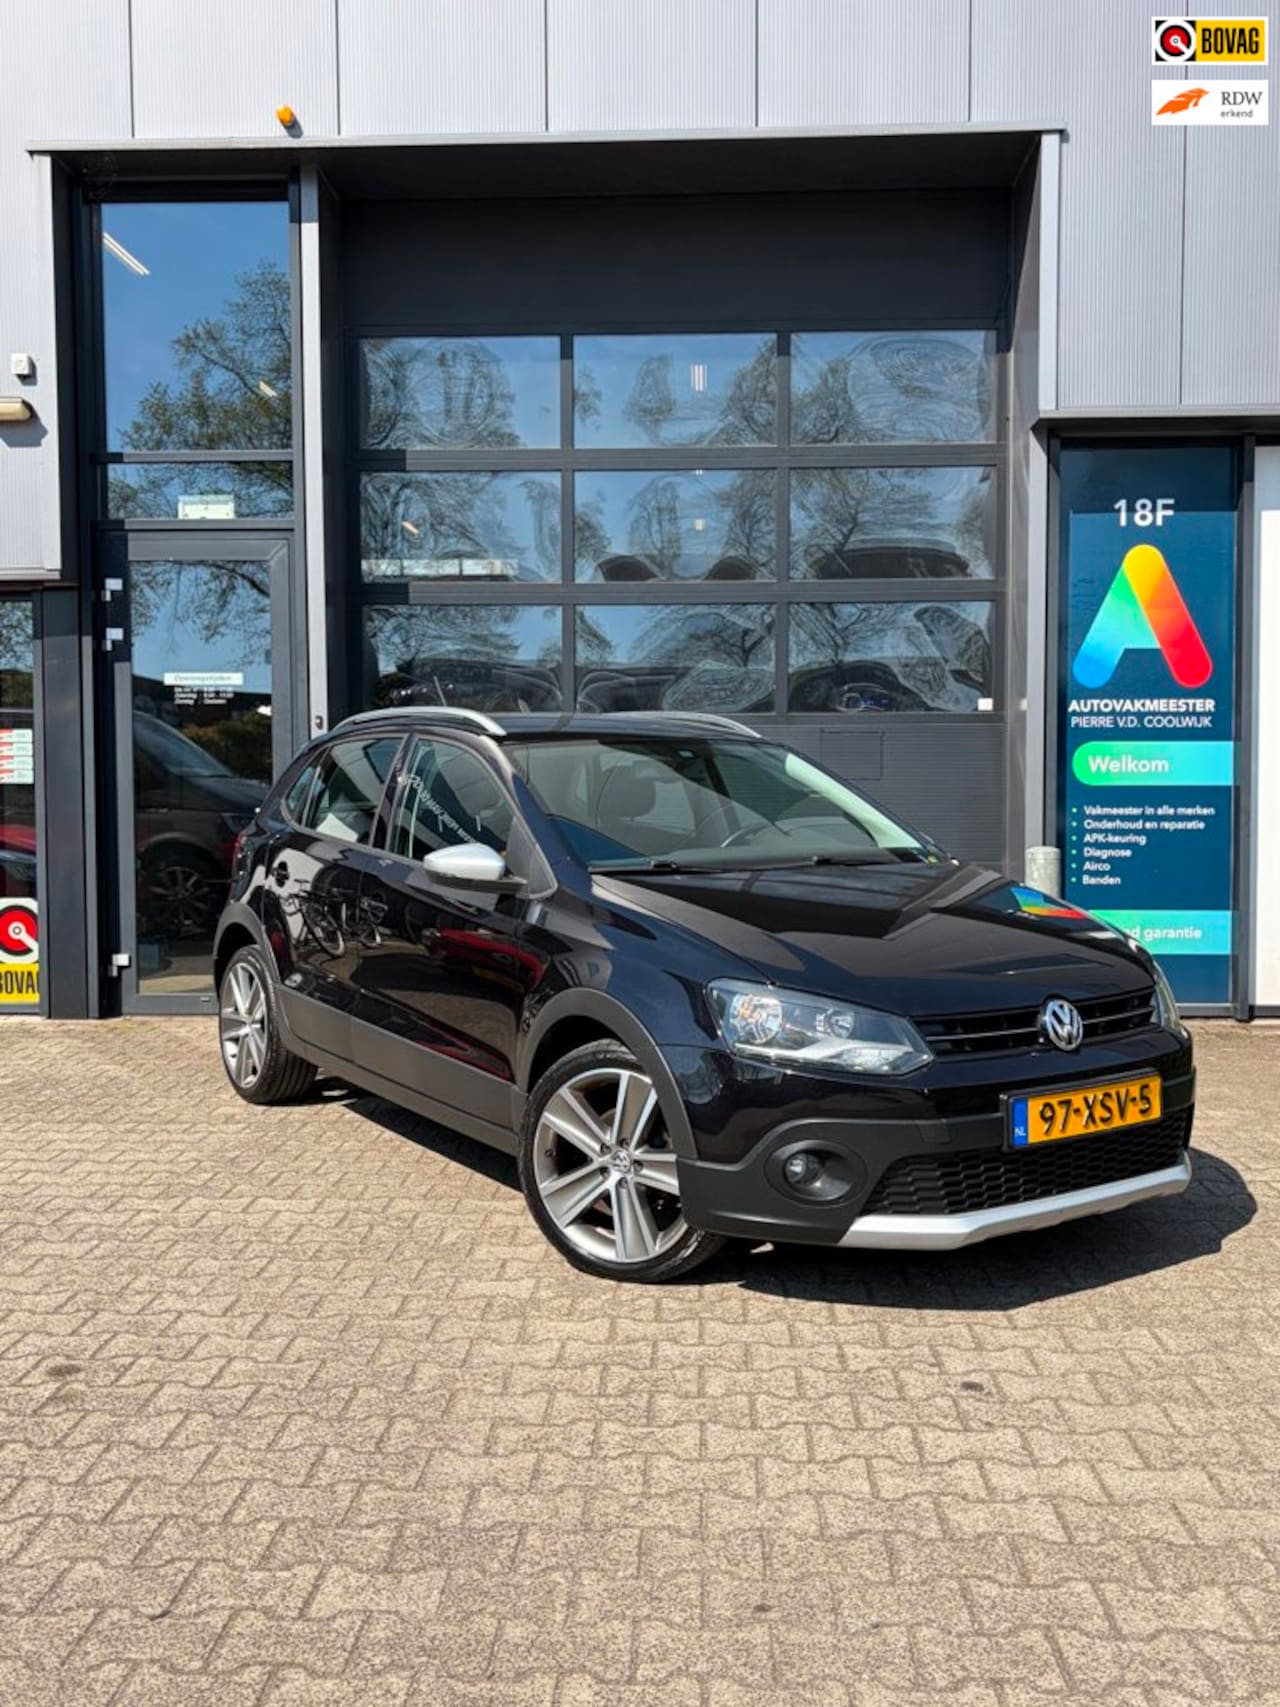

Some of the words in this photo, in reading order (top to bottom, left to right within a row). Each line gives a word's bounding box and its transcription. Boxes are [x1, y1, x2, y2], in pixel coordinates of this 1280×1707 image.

[1114, 499, 1175, 527] 18F
[1068, 699, 1216, 713] AUTOVAKMEESTER
[1071, 716, 1114, 728] PIERRE
[1117, 716, 1140, 728] V.D.
[1144, 716, 1212, 728] COOLWIJK
[1088, 755, 1169, 773] Welkom
[1084, 806, 1143, 815] Vakmeester
[1145, 806, 1154, 815] in
[1157, 806, 1174, 815] alle
[1177, 806, 1215, 815] merken
[1084, 820, 1143, 829] Onderhoud
[1160, 820, 1205, 832] reparatie
[1083, 834, 1146, 846] APK-keuring
[1084, 848, 1132, 859] Diagnose
[1083, 862, 1111, 871] Airco
[1082, 876, 1121, 885] Banden
[1144, 927, 1202, 941] garantie
[1040, 1084, 1151, 1135] 97-XSV-5
[1014, 1128, 1027, 1137] NL
